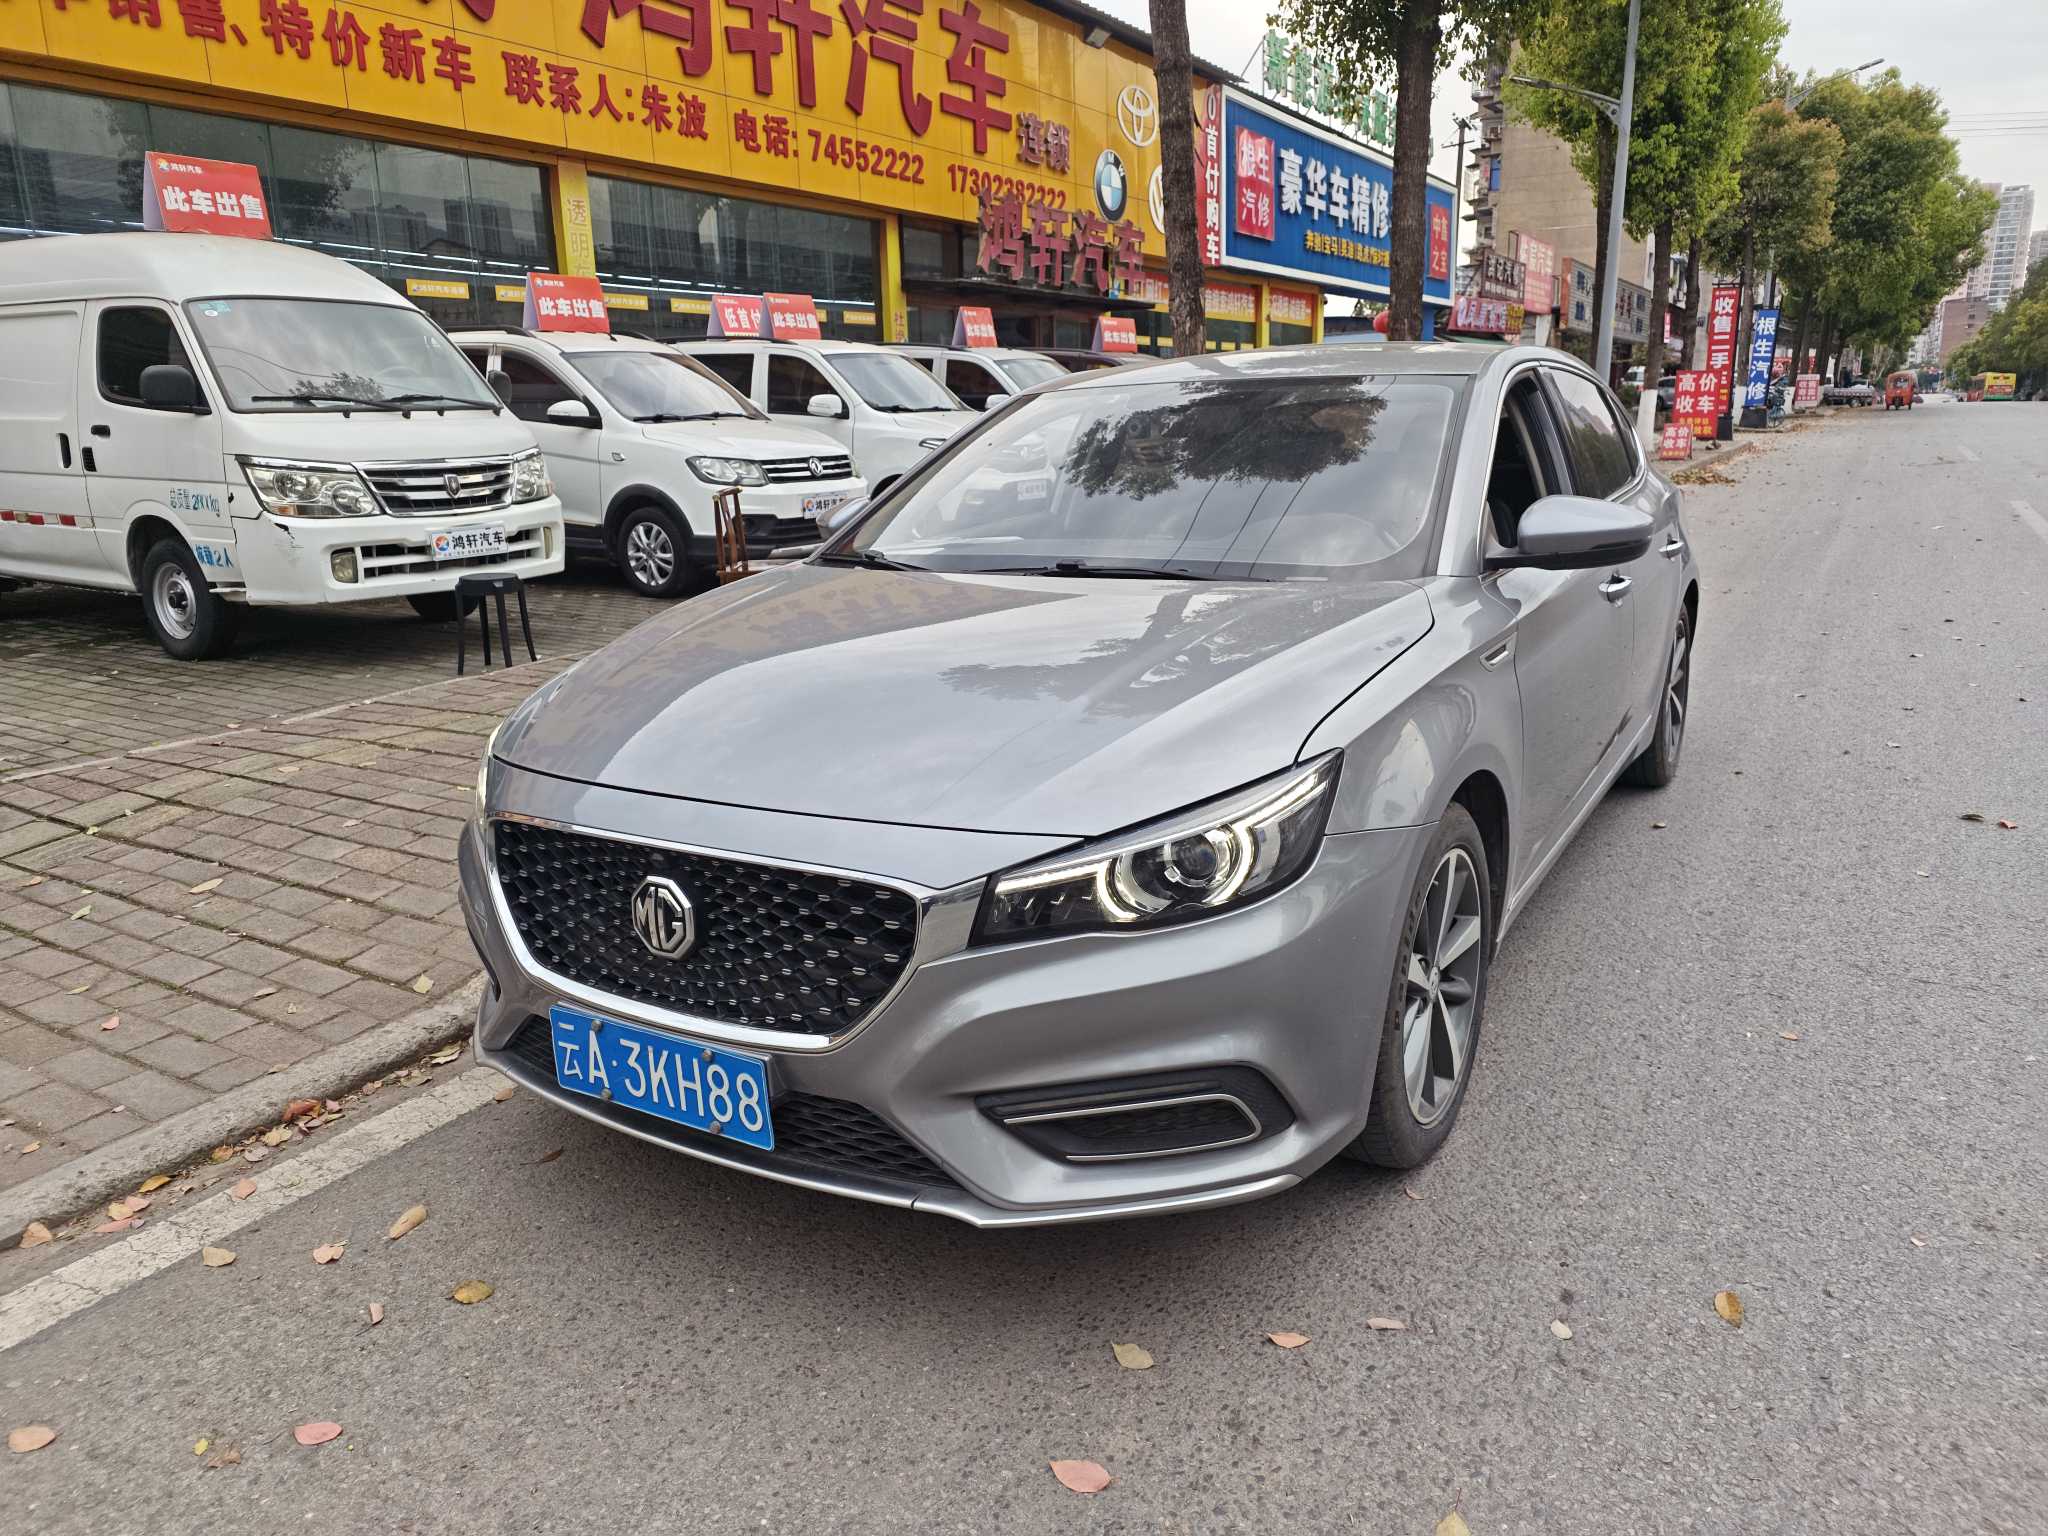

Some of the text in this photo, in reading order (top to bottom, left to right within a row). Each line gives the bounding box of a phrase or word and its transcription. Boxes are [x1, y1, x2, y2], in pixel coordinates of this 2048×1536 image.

[807, 128, 925, 185] 74552222
[1240, 138, 1271, 183] 根生
[161, 185, 265, 221] 此车出售
[1241, 187, 1271, 229] 汽修
[1280, 148, 1390, 239] 豪华车精修
[977, 186, 1146, 297] 鸿轩汽车
[538, 296, 606, 319] 此车出售
[773, 311, 818, 329] 此车出售
[1747, 317, 1777, 401] 根生汽修
[1678, 373, 1718, 393] 高价
[1675, 394, 1715, 414] 收车
[1663, 438, 1687, 449] 收车
[1665, 426, 1690, 438] 高价
[451, 531, 505, 550] 鸿轩汽车
[635, 885, 685, 951] MG
